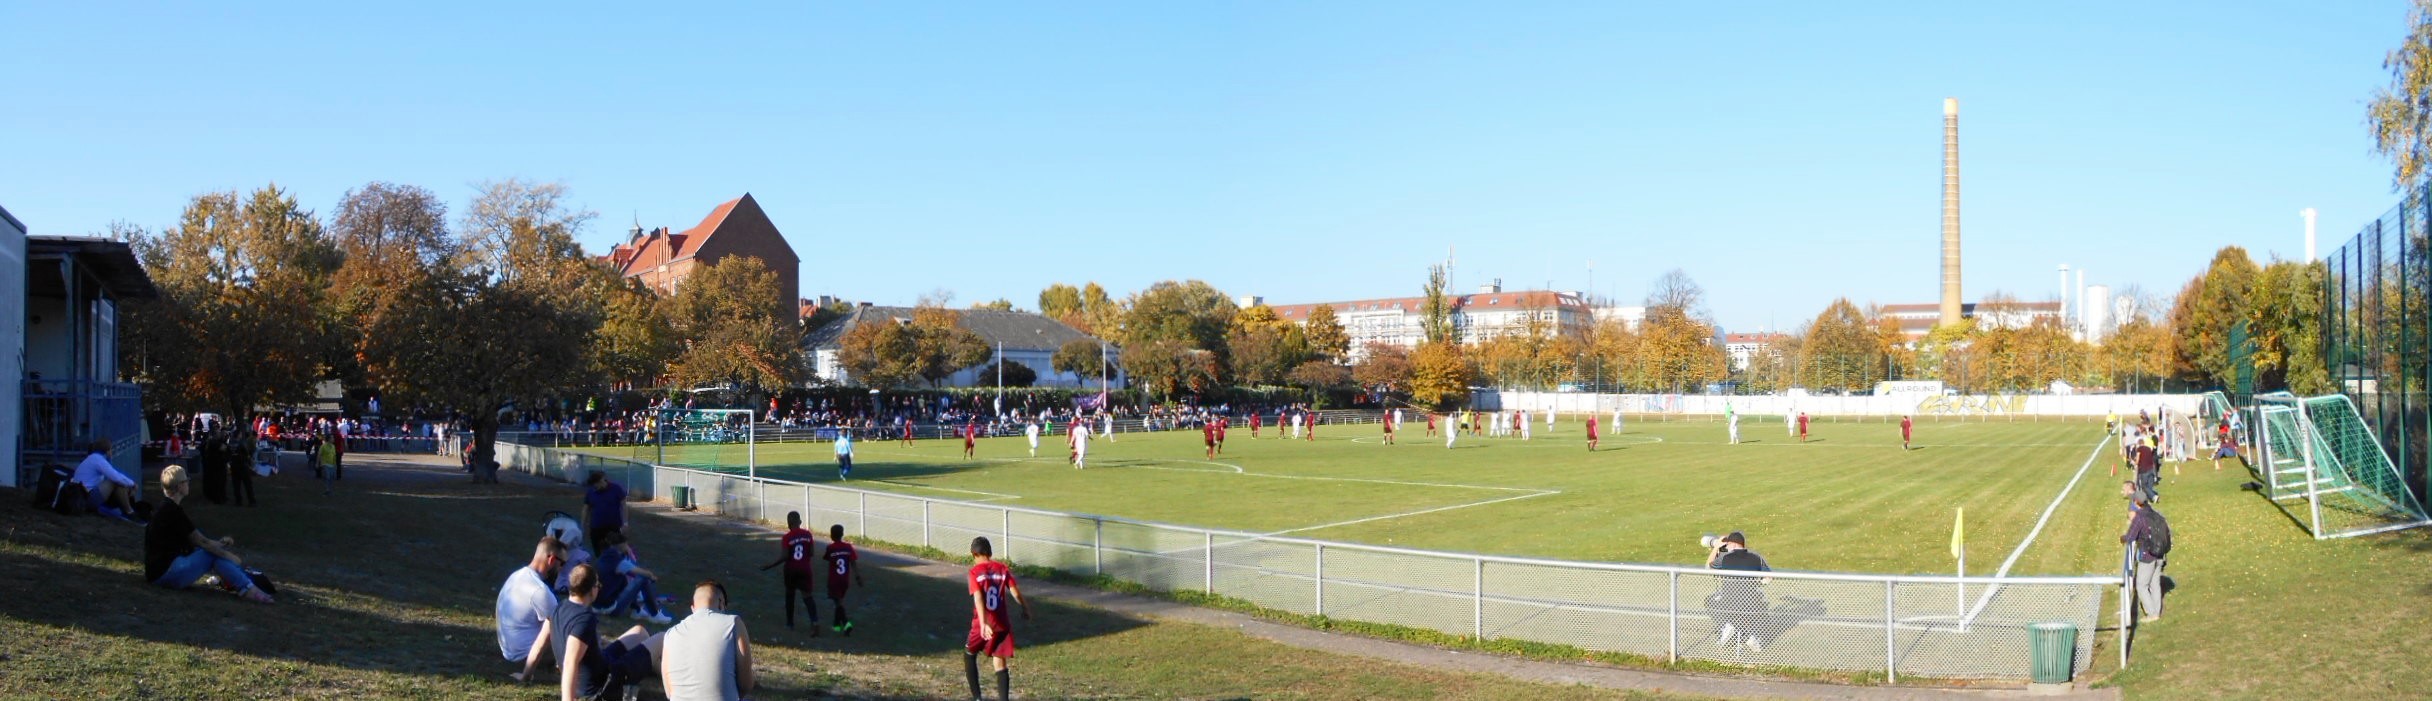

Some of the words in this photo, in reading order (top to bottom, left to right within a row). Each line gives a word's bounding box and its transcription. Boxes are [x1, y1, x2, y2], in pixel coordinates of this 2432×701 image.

[1891, 385, 1937, 393] ALLROUND
[794, 544, 804, 560] 8
[836, 558, 846, 575] 3
[986, 585, 998, 611] 6
